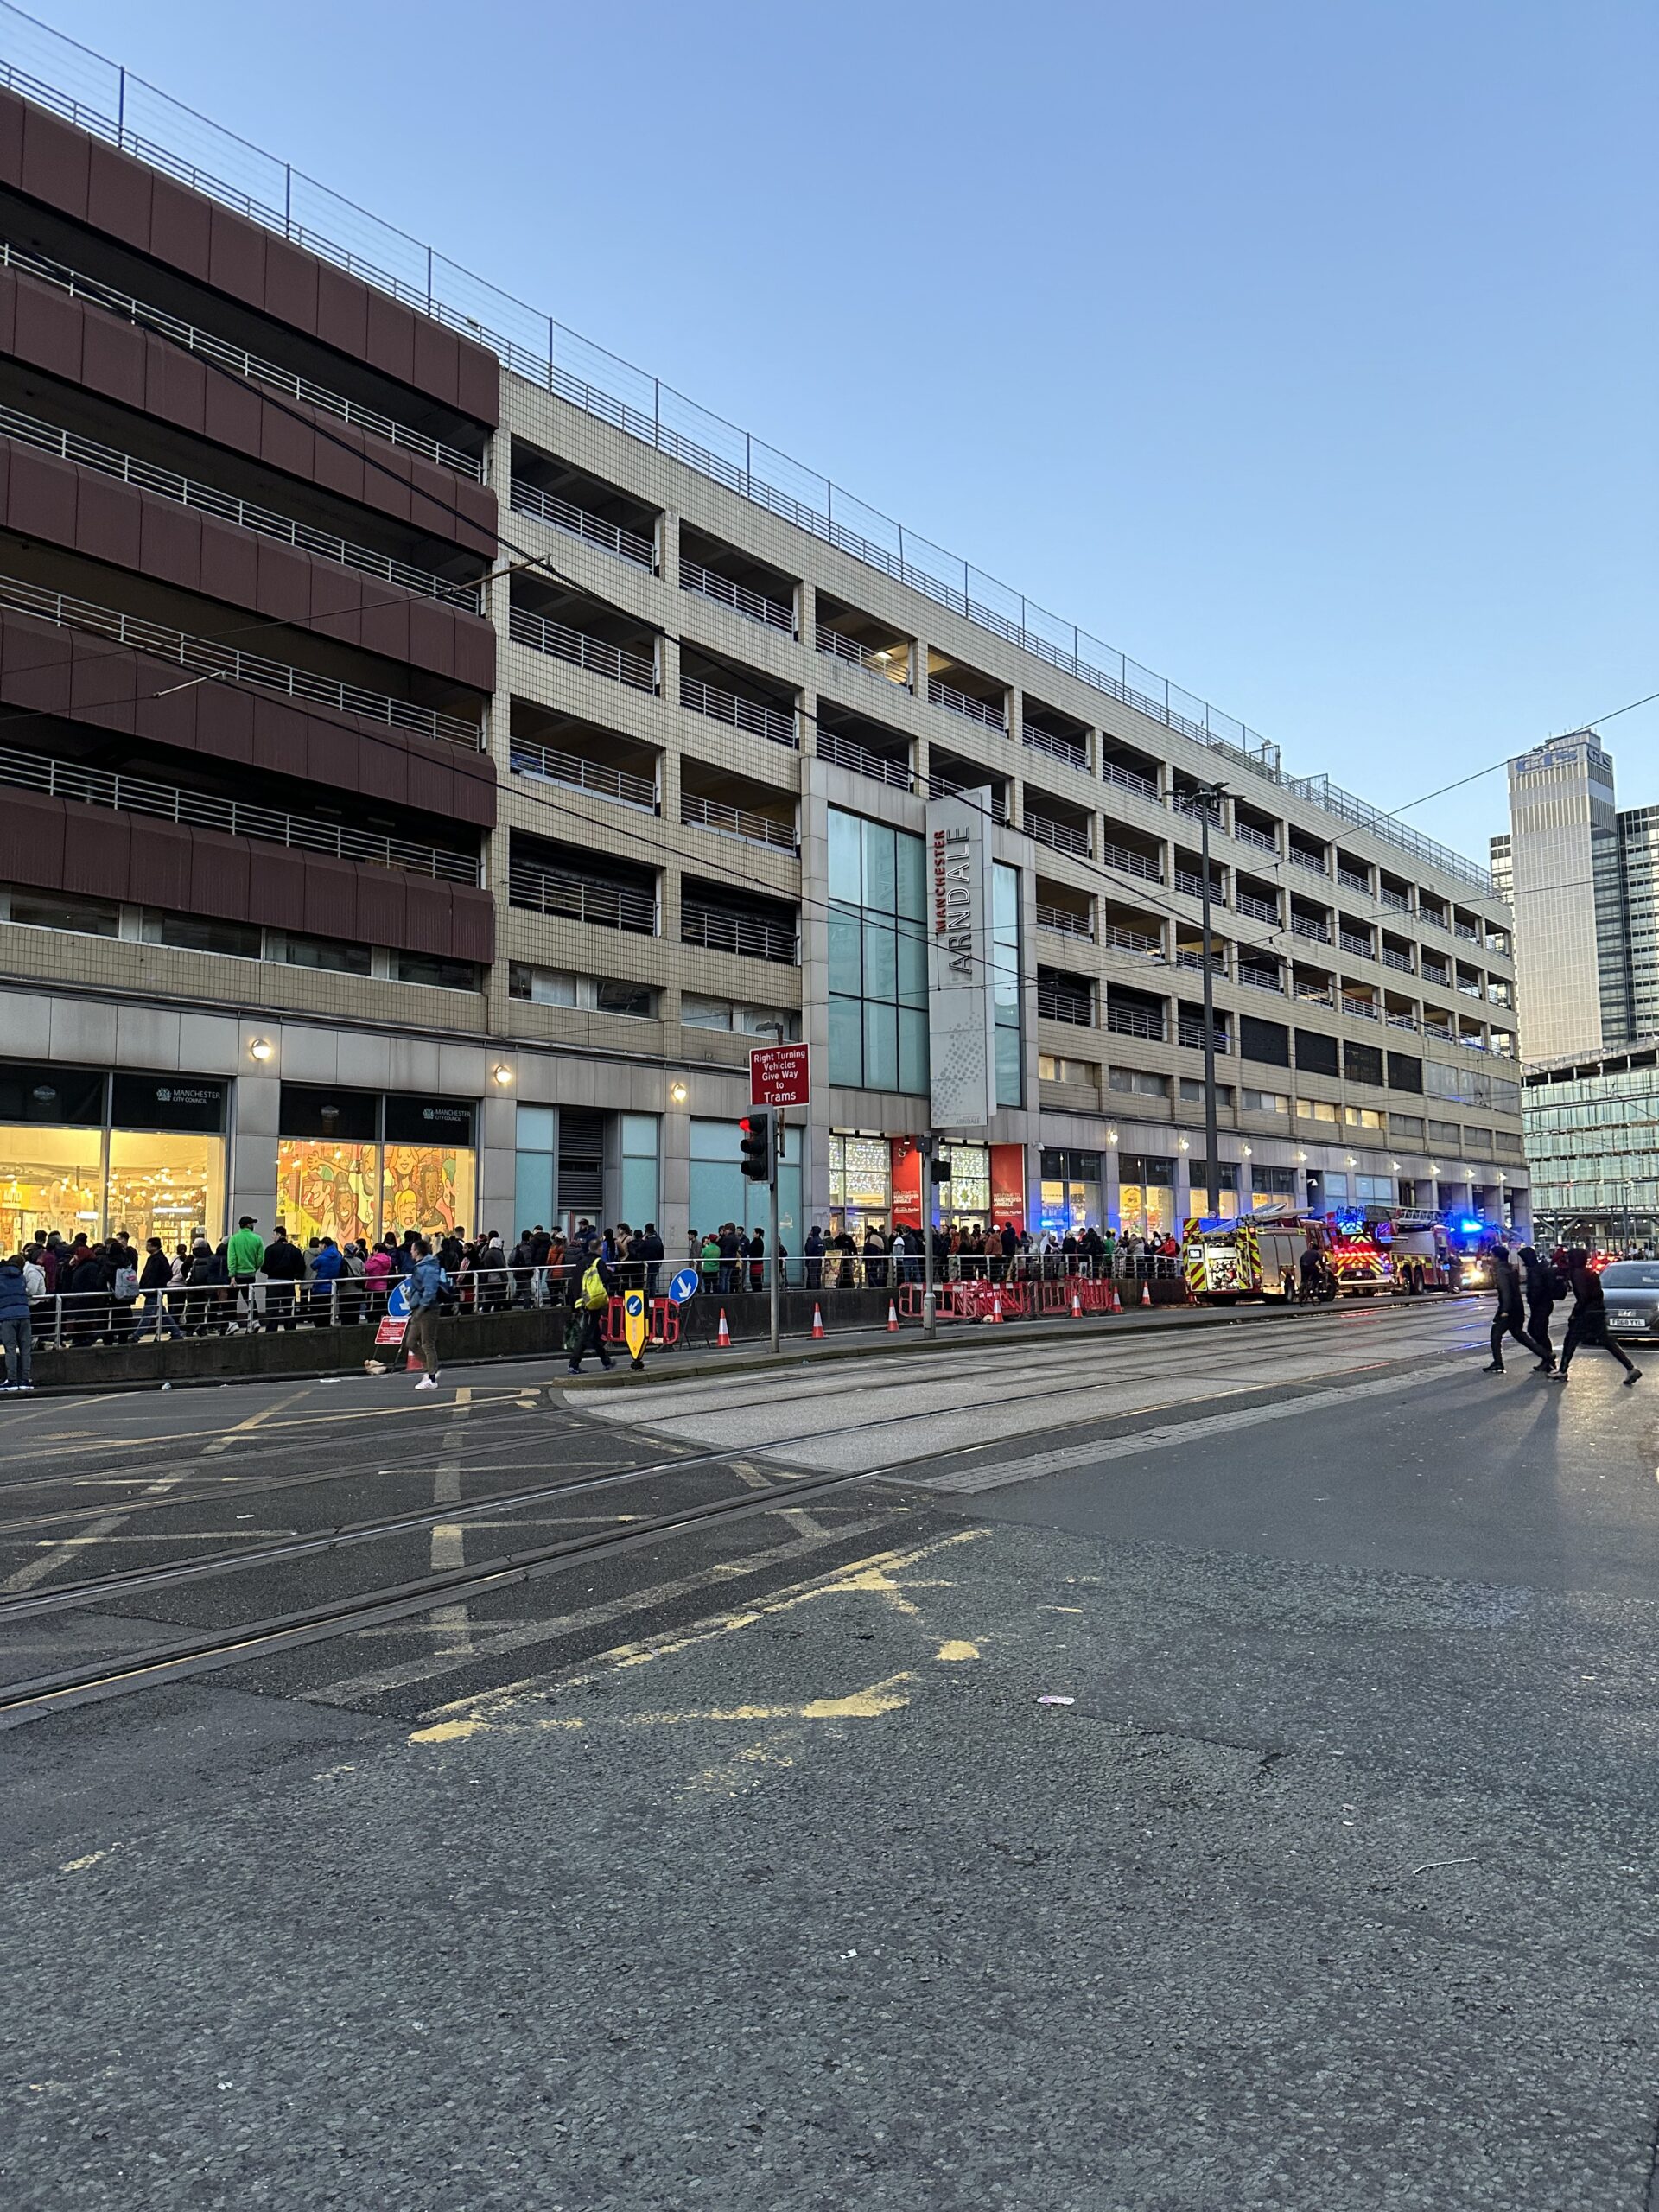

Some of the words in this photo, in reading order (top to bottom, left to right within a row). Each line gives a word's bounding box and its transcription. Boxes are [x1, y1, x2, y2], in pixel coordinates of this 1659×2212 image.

[1516, 750, 1577, 772] CIS
[1587, 745, 1611, 770] CIS
[934, 830, 946, 934] MANCHESTER
[946, 826, 972, 974] ARNDALE
[753, 1052, 774, 1063] Right
[776, 1050, 805, 1059] Turning
[764, 1061, 796, 1071] Vehicles
[762, 1071, 779, 1081] Give
[781, 1071, 798, 1079] Way
[775, 1081, 785, 1090] to
[173, 1089, 221, 1099] MANCHESTER
[764, 1092, 797, 1103] Trams
